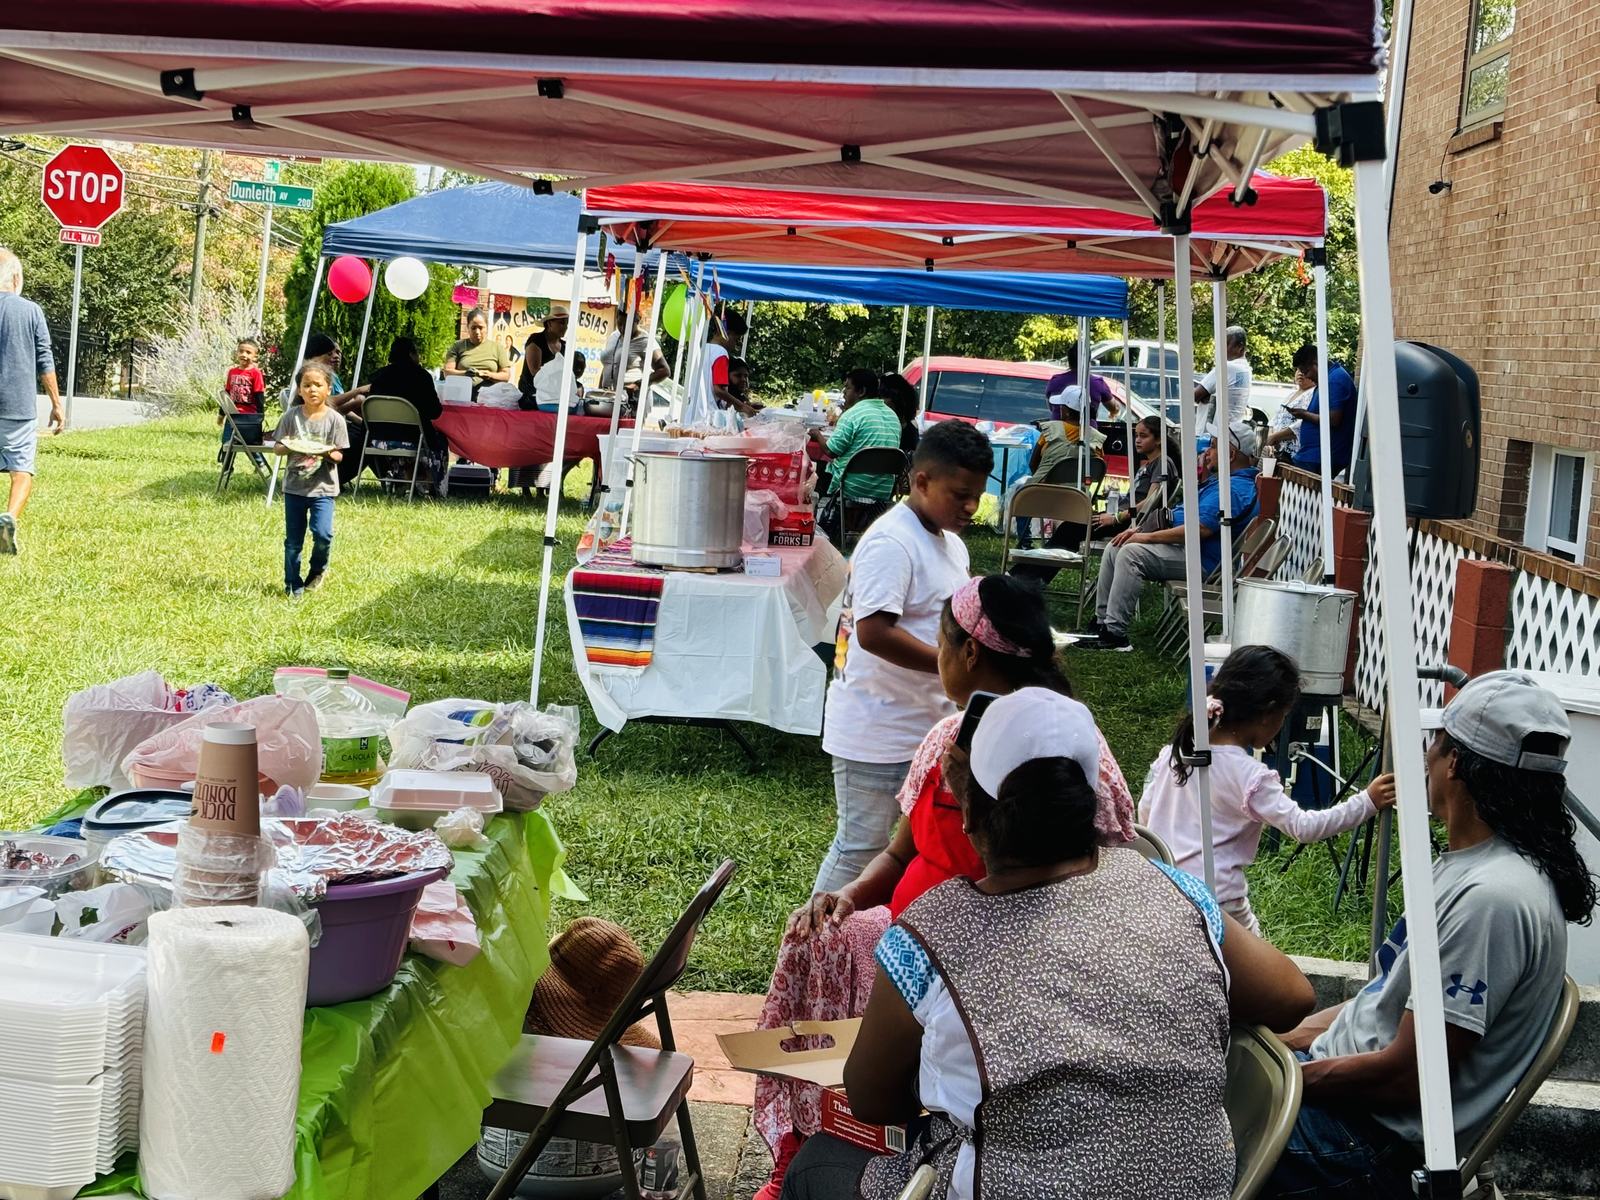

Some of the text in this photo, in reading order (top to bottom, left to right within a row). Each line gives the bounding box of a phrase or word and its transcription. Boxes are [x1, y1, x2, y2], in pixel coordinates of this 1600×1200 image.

[47, 168, 119, 204] STOP
[231, 182, 312, 208] Dunleith AV 200
[61, 231, 98, 243] ALL WAY
[773, 535, 801, 546] FORKS
[341, 752, 371, 762] CANOLA
[200, 802, 236, 821] DUCK
[832, 1099, 854, 1117] Than
